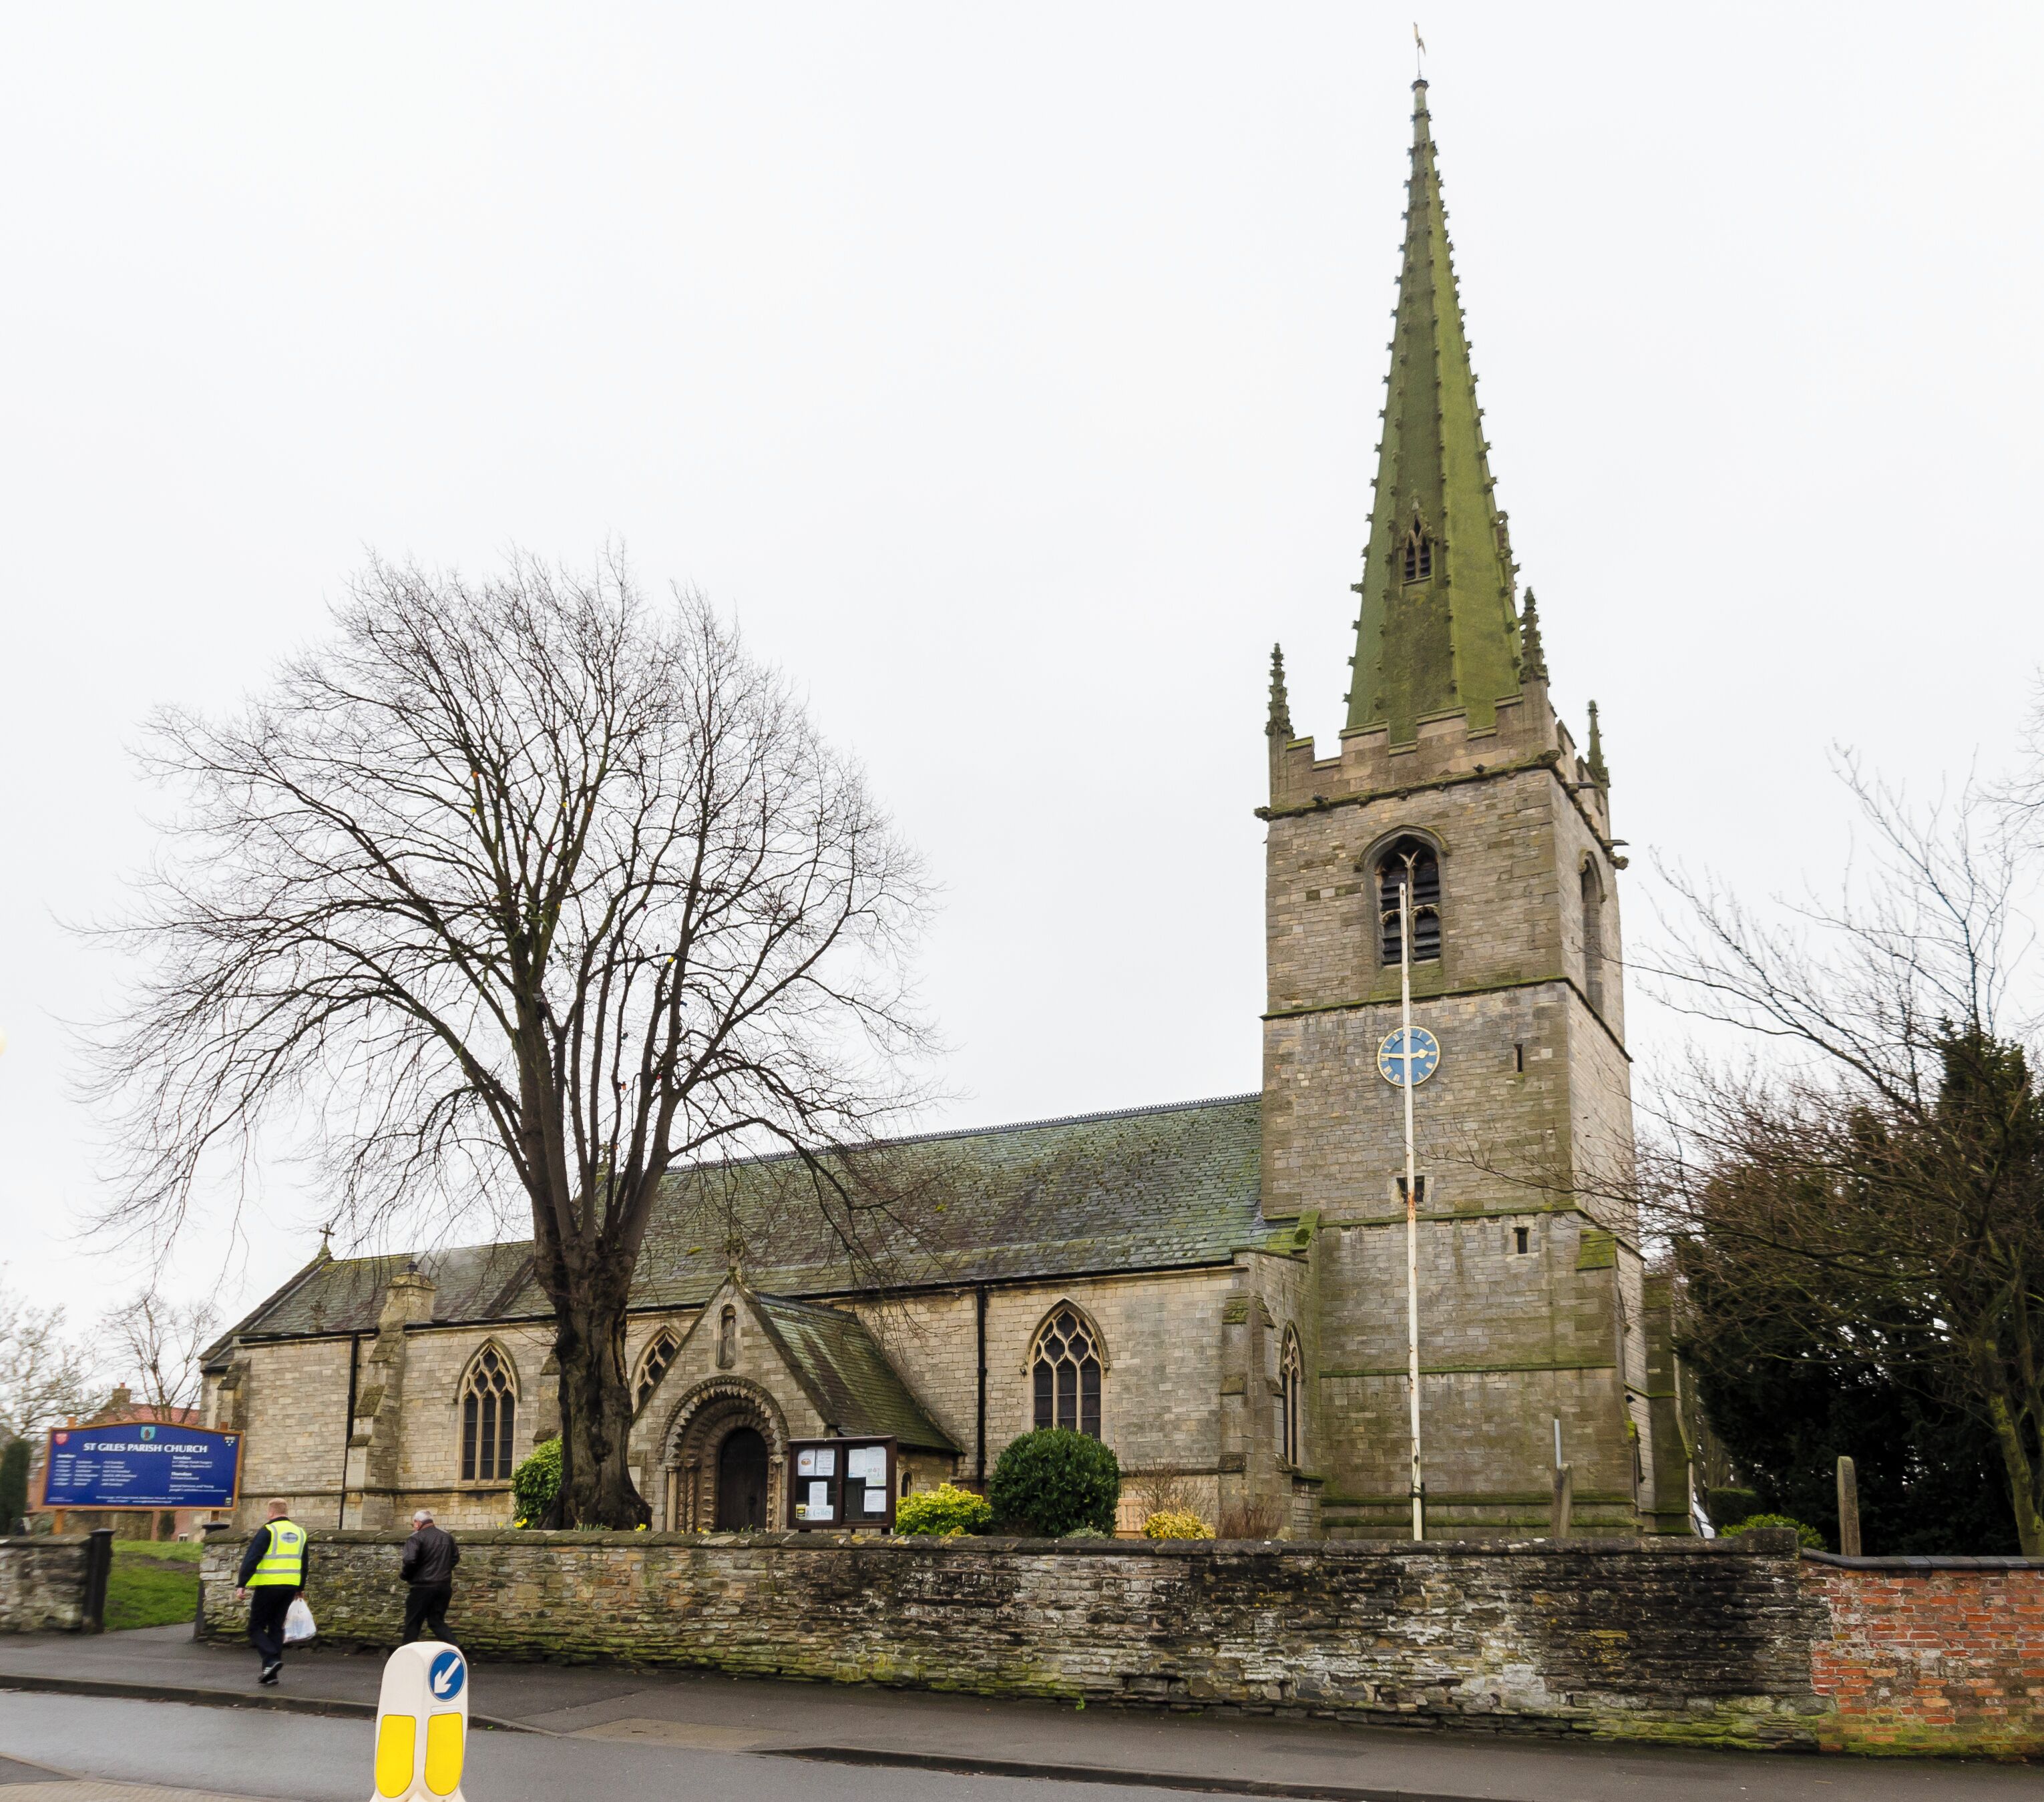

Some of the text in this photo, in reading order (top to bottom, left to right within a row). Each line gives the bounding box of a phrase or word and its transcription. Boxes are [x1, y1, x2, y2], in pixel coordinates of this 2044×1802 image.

[83, 1443, 207, 1453] ST GILES PARISH CHURCH
